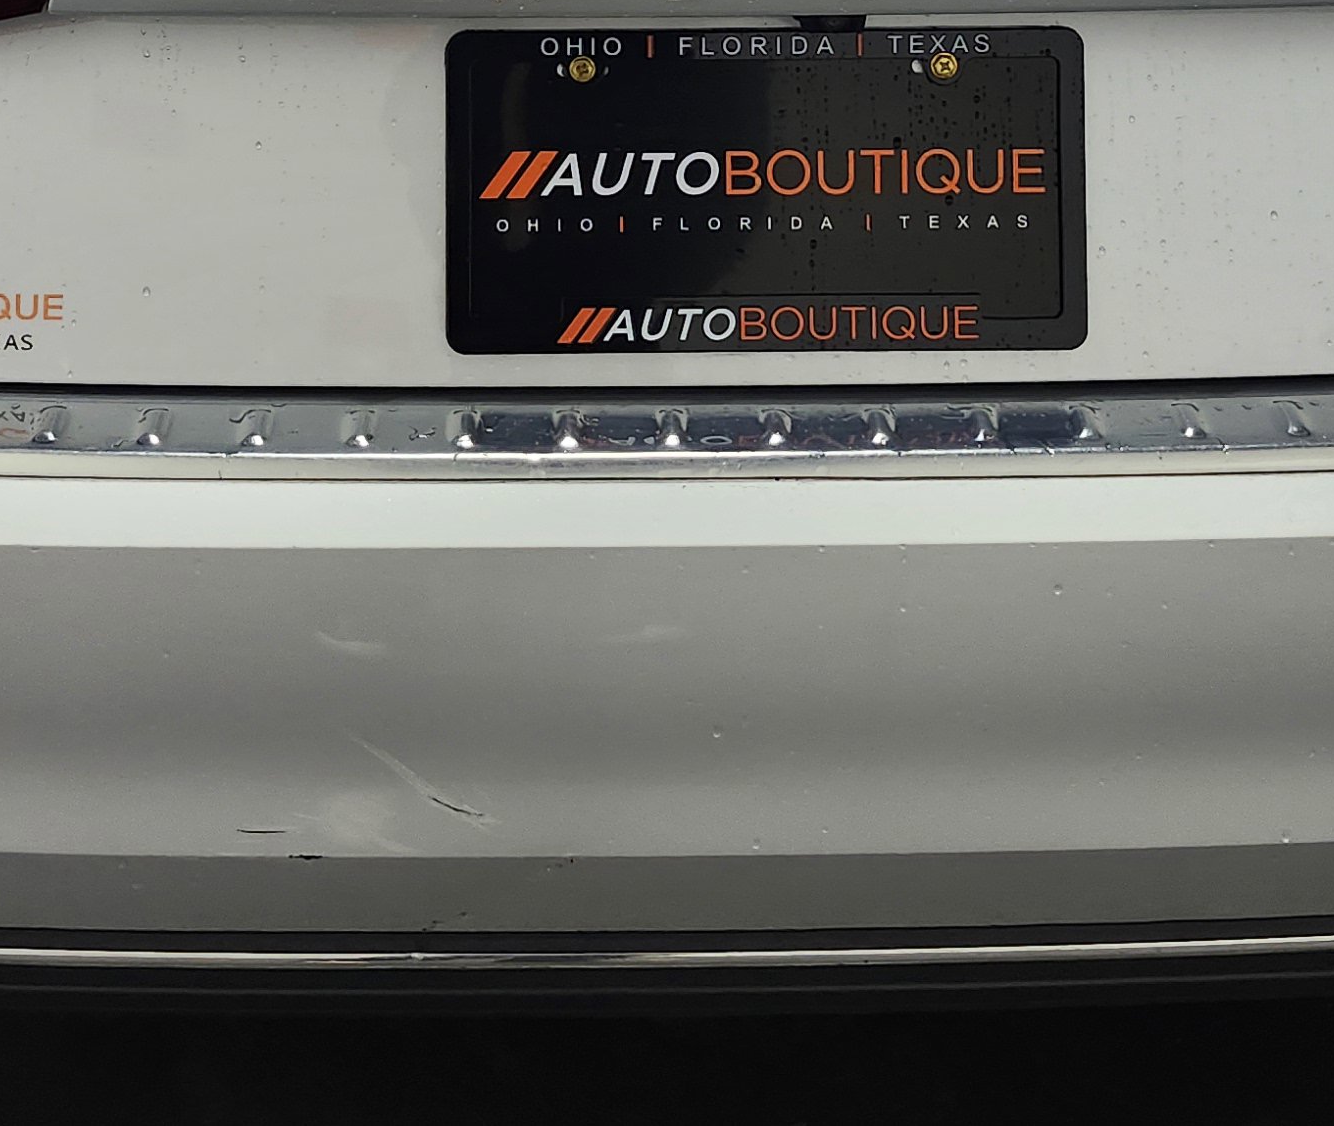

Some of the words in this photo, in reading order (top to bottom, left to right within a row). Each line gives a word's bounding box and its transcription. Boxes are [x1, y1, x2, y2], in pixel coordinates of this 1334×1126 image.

[540, 37, 623, 57] OHIO
[678, 35, 836, 57] FLORIDA
[887, 33, 991, 55] TEXAS
[540, 148, 1047, 198] AUTOBOUTIQUE
[496, 217, 594, 233] OHIO
[652, 215, 834, 232] FLORIDA
[899, 213, 1030, 230] TEXAS
[603, 305, 980, 343] AUTOBOUTIQUE
